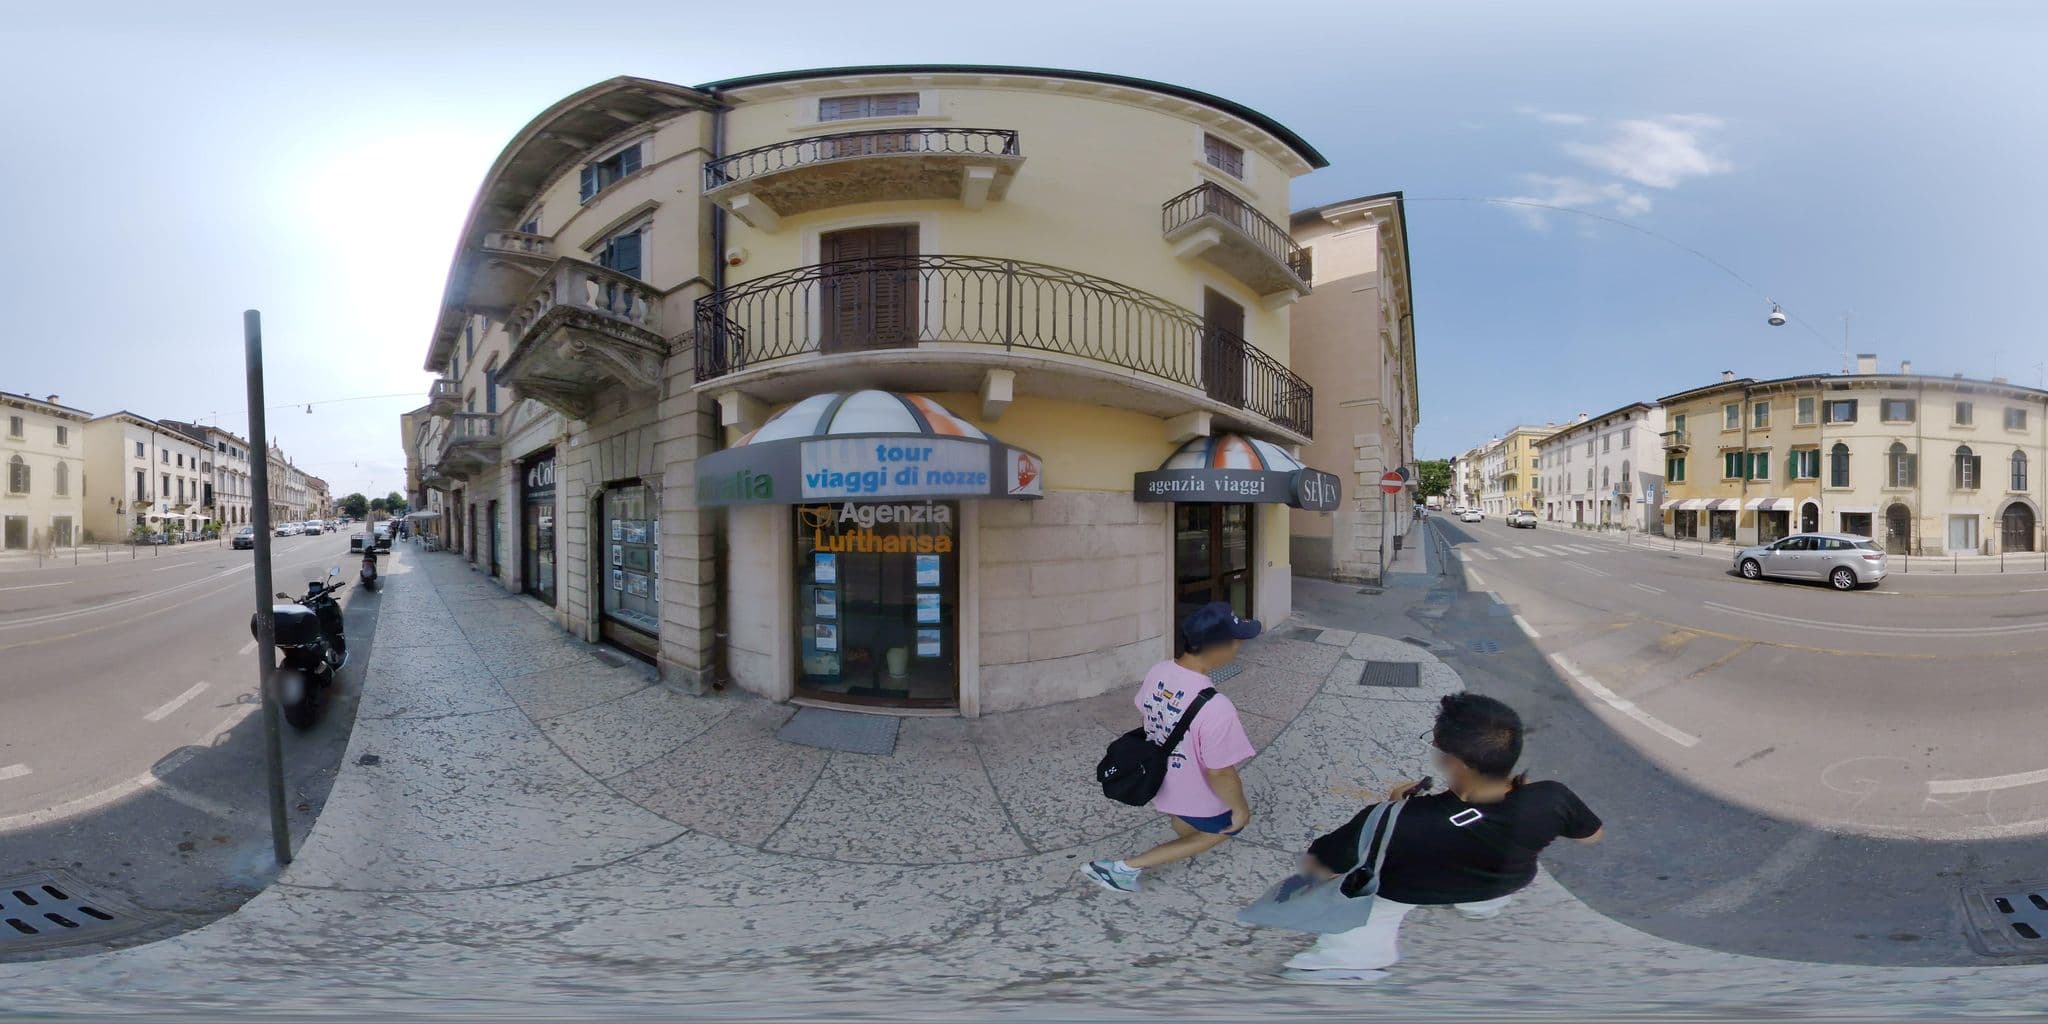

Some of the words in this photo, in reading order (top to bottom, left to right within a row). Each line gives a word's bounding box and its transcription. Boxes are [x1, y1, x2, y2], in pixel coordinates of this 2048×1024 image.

[875, 444, 933, 462] tour
[806, 467, 887, 493] viaggi
[895, 467, 919, 486] di
[926, 470, 987, 486] nozze
[1149, 476, 1205, 495] agenzia
[1214, 476, 1265, 496] viaggi
[1304, 473, 1336, 508] SEVEN
[838, 501, 951, 529] Agenzia
[814, 527, 952, 553] Lufthansa
